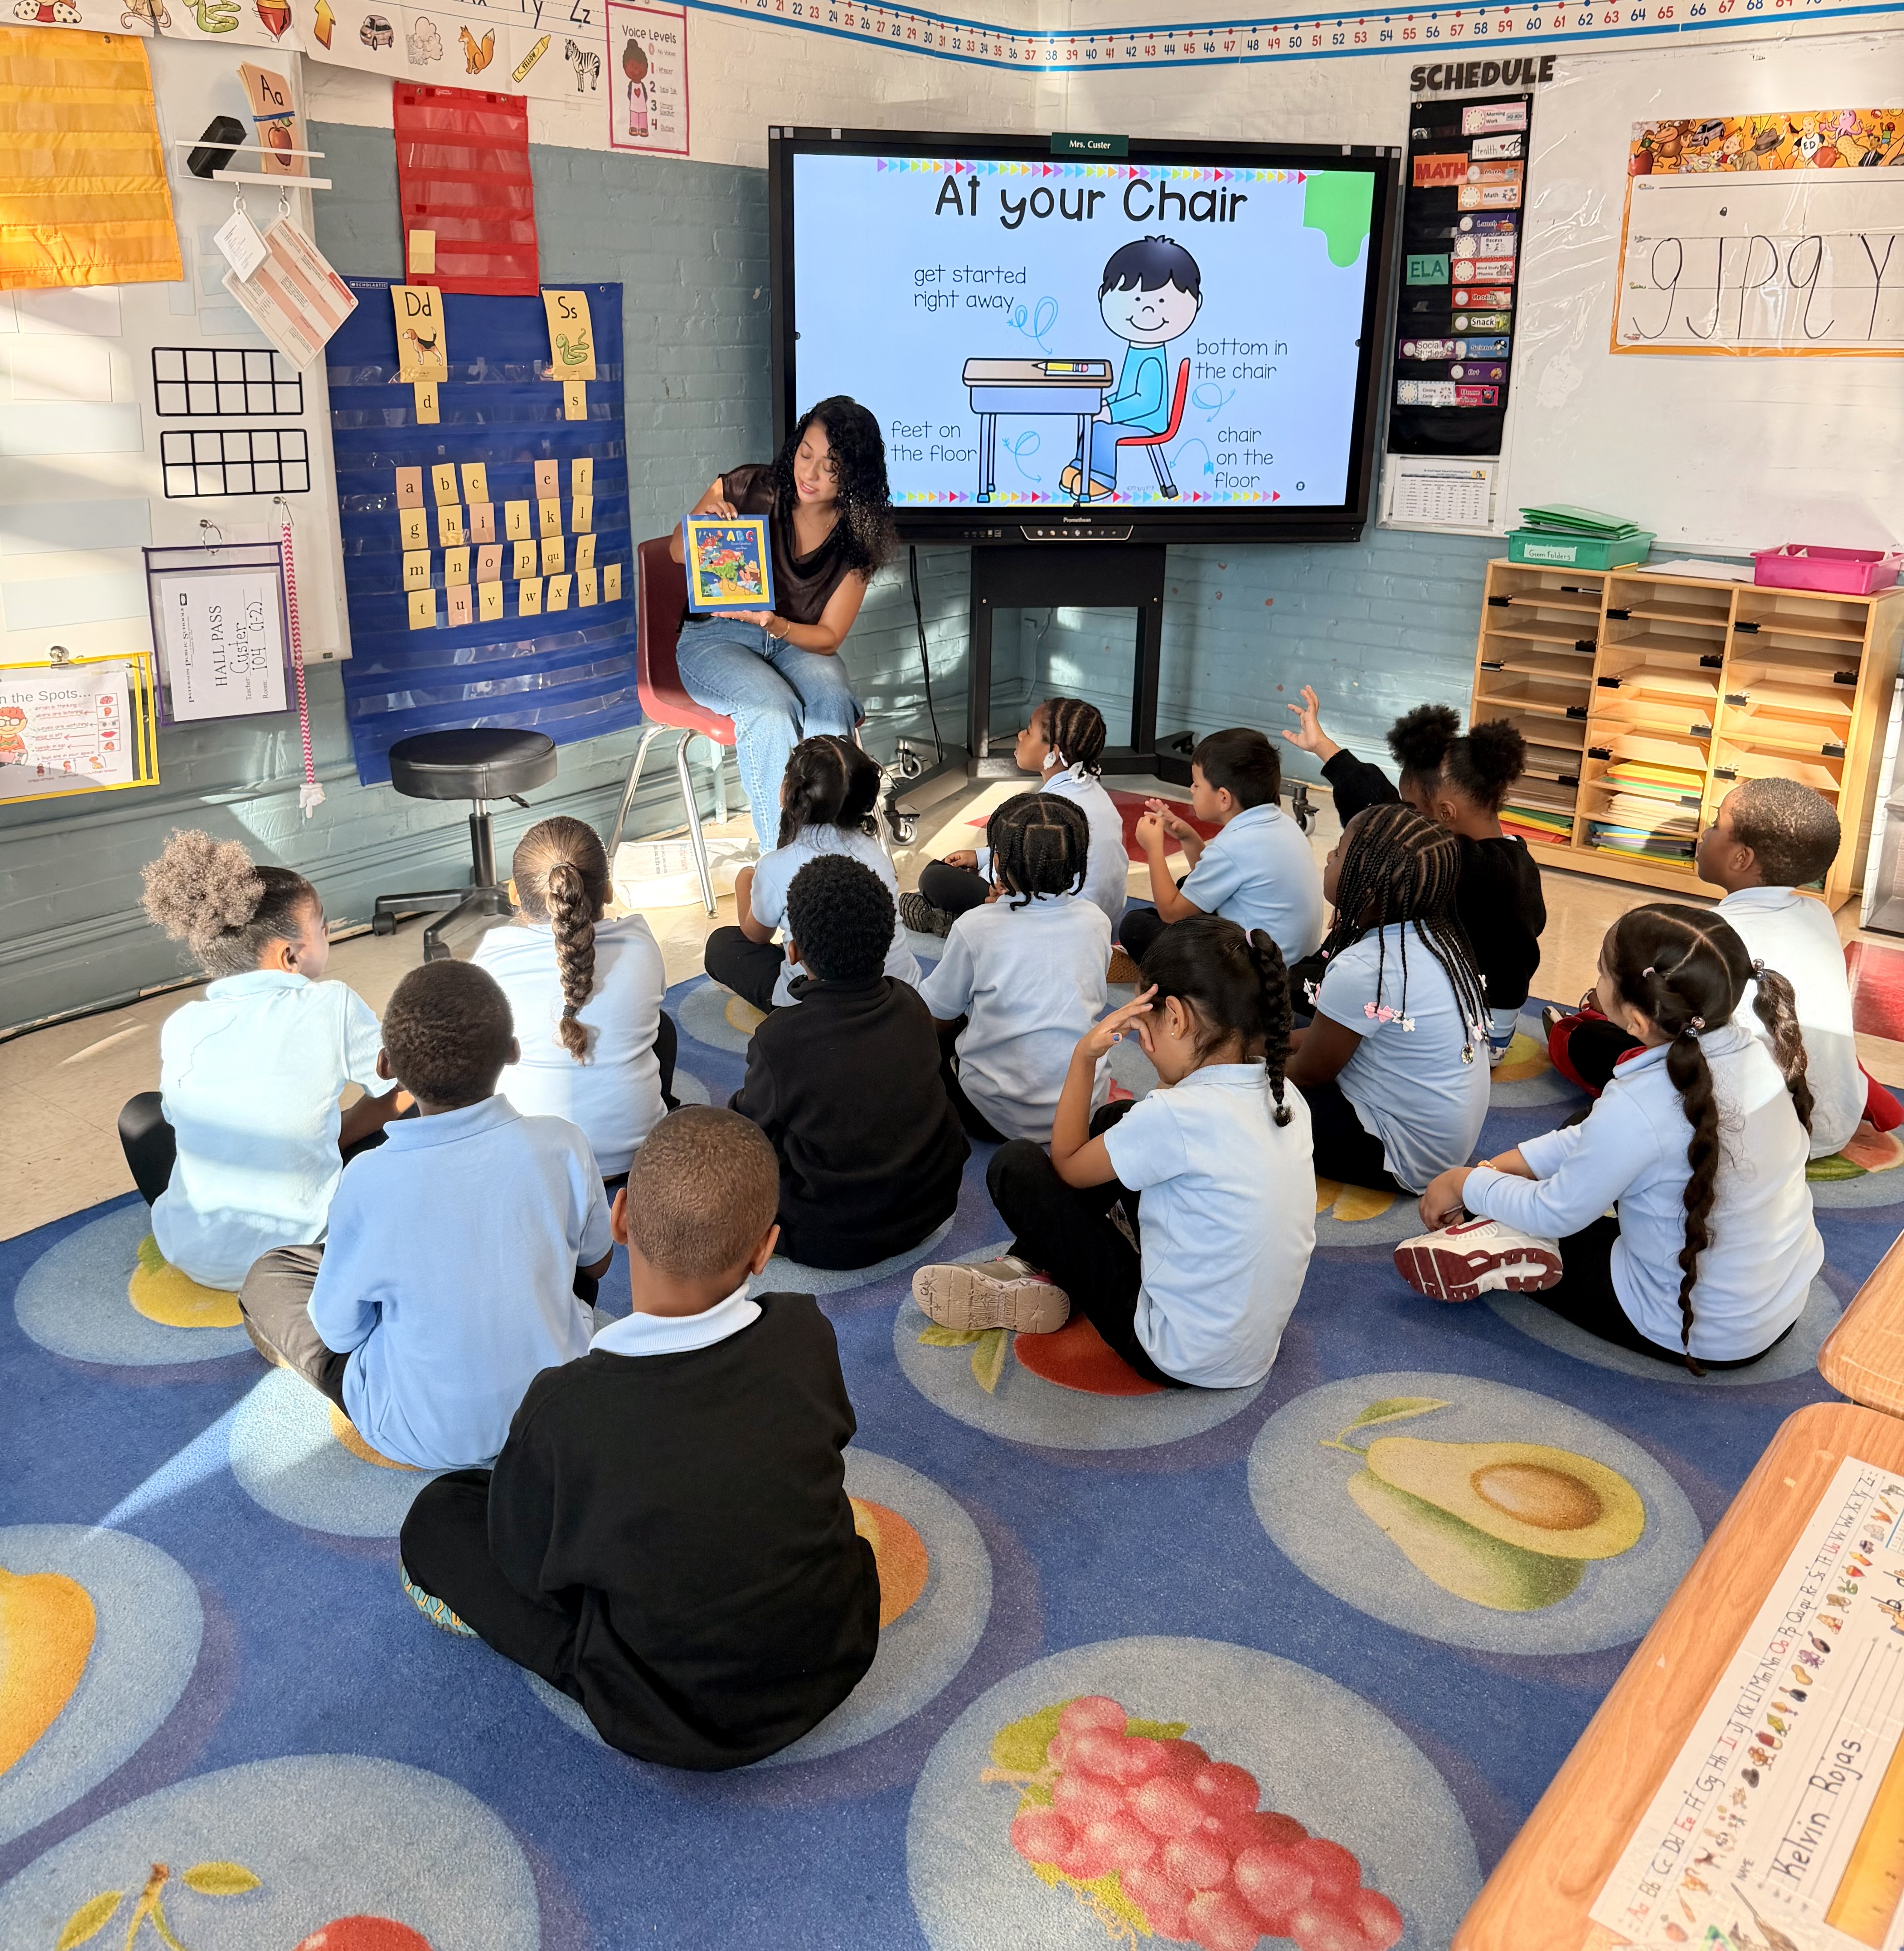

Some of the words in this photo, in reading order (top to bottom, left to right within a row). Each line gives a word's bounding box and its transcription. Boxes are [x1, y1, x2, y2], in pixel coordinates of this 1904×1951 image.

[622, 25, 646, 39] Voice
[649, 29, 676, 44] Levels
[777, 0, 784, 11] 21
[810, 6, 819, 18] 23
[845, 14, 854, 26] 25
[861, 17, 870, 29] 26
[892, 24, 900, 36] 28
[924, 32, 932, 44] 30
[953, 38, 961, 49] 32
[980, 43, 987, 54] 34
[1009, 47, 1017, 59] 36
[1046, 50, 1057, 60] 38
[1086, 48, 1097, 59] 40
[1126, 46, 1136, 57] 42
[1164, 44, 1175, 55] 44
[1203, 42, 1215, 53] 46
[1247, 40, 1259, 51] 48
[1289, 36, 1302, 48] 50
[1332, 33, 1345, 44] 52
[1380, 30, 1393, 41] 54
[1426, 26, 1440, 37] 56
[1474, 22, 1488, 34] 58
[1526, 18, 1541, 30] 60
[1578, 13, 1593, 26] 62
[1630, 8, 1646, 21] 64
[1690, 3, 1706, 16] 66
[1746, 0, 1763, 10] 68
[521, 52, 536, 70] YELLOW
[1410, 55, 1556, 91] SCHEDULE
[261, 74, 284, 106] Aa
[649, 80, 656, 93] 2
[651, 100, 657, 111] 3
[651, 118, 657, 130] 4
[1069, 140, 1086, 149] Mrs.
[1088, 141, 1111, 150] Custer
[1475, 145, 1497, 156] Health
[1804, 141, 1818, 150] ED
[1415, 162, 1466, 180] MATH
[935, 175, 980, 217] At
[1000, 187, 1106, 230] your
[1123, 179, 1248, 222] Chair
[914, 264, 946, 286] get
[953, 264, 1026, 285] started
[1411, 260, 1444, 277] ELA
[405, 292, 431, 317] Dd
[557, 296, 577, 319] Ss
[914, 289, 959, 312] right
[966, 296, 1014, 313] away
[1472, 317, 1494, 325] Snack
[1197, 338, 1268, 356] bottom
[1275, 339, 1288, 356] in
[1417, 341, 1440, 349] Social
[1195, 362, 1226, 379] the
[1232, 363, 1277, 379] chair
[424, 394, 432, 408] d
[573, 396, 578, 406] s
[891, 420, 933, 438] feet
[939, 425, 961, 438] on
[1217, 426, 1262, 443] chair
[890, 444, 923, 462] the
[930, 445, 977, 462] floor
[1216, 452, 1237, 465] on
[1243, 449, 1274, 465] the
[406, 483, 414, 493] a
[441, 478, 449, 490] b
[472, 479, 479, 489] c
[544, 475, 551, 485] e
[580, 470, 585, 482] f
[1215, 471, 1260, 488] floor
[411, 523, 419, 539] g
[447, 519, 455, 530] h
[481, 517, 485, 528] i
[515, 514, 520, 529] j
[547, 511, 555, 523] k
[581, 507, 584, 518] l
[410, 566, 424, 576] m
[454, 562, 461, 572] n
[485, 558, 493, 567] o
[522, 556, 530, 568] p
[547, 553, 559, 563] qu
[583, 548, 588, 558] r
[1547, 551, 1571, 560] Folders
[420, 602, 426, 614] t
[457, 601, 465, 610] u
[488, 597, 495, 606] v
[526, 592, 536, 602] w
[555, 588, 562, 598] x
[585, 583, 591, 596] y
[610, 578, 616, 587] z
[209, 605, 224, 642] PASS
[228, 622, 249, 674] Custer
[212, 645, 228, 686] HALL
[252, 647, 268, 670] 104
[12, 693, 33, 703] the
[39, 690, 91, 703] Spots...
[1627, 1902, 1650, 1923] Aa
[1639, 1880, 1660, 1898] Bb
[1663, 1834, 1685, 1854] Dd
[1674, 1817, 1696, 1833] Ee
[1696, 1777, 1725, 1791] Gg
[1770, 1640, 1790, 1654] Oo
[1823, 1542, 1840, 1554] Uu
[1858, 1477, 1876, 1487] Zz
[1771, 1811, 1830, 1882] Kelvin
[1808, 1739, 1863, 1796] Rojas
[1736, 1858, 1755, 1882] NAME
